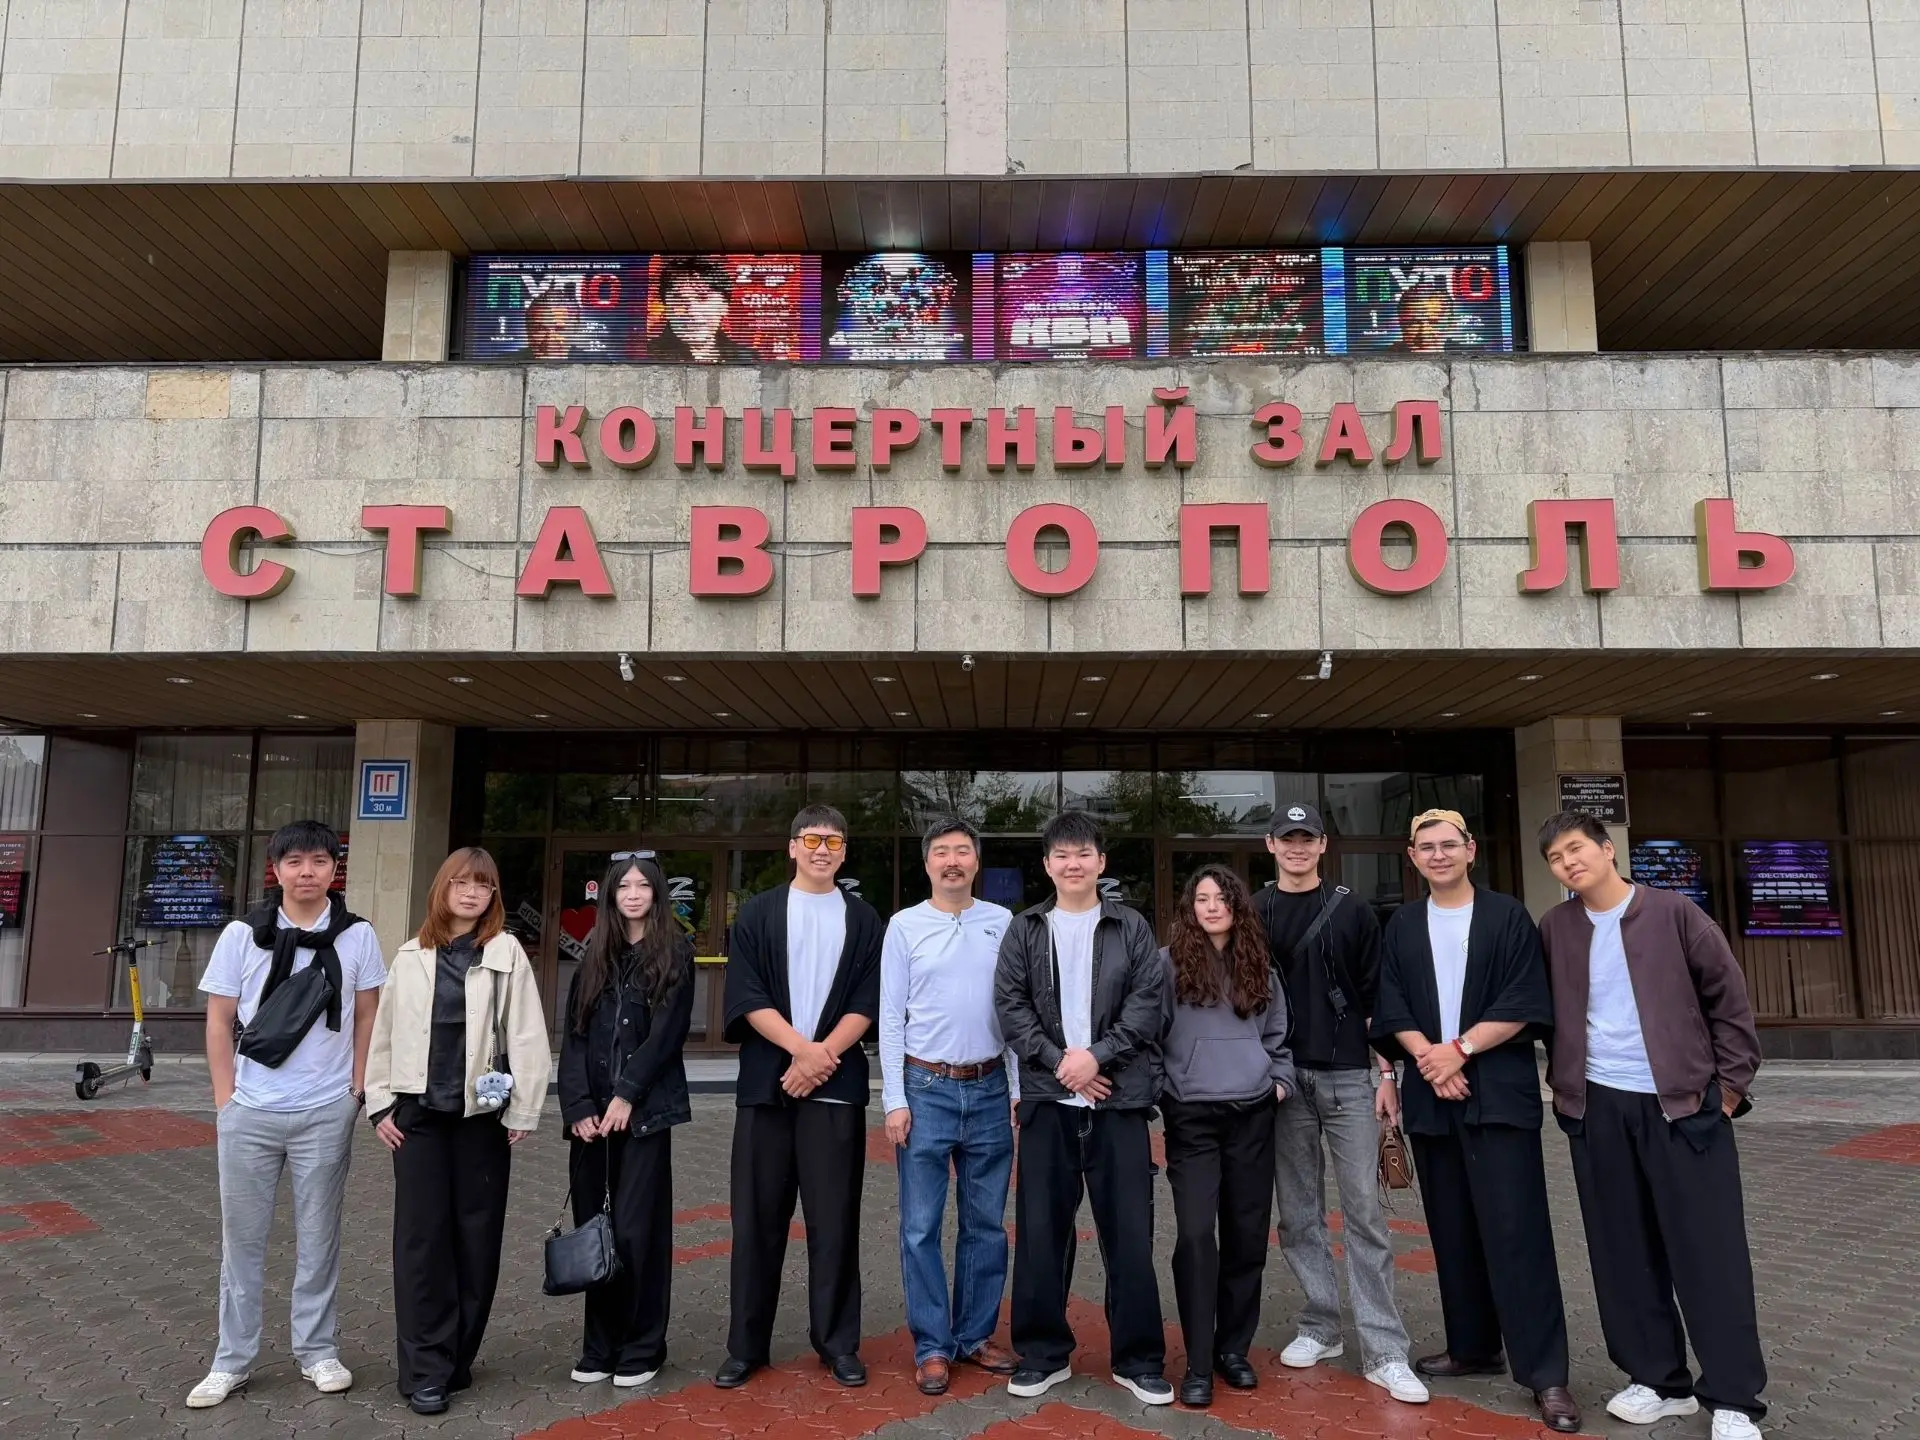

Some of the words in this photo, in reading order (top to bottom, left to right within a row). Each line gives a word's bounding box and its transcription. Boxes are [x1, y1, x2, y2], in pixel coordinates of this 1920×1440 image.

[535, 386, 1197, 481] КОНЦЕРТНЫЙ
[1250, 400, 1443, 468] ЗАЛ
[200, 496, 1796, 600] СТАВРОПОЛЬ
[373, 773, 396, 793] ПГ
[373, 803, 385, 812] 30
